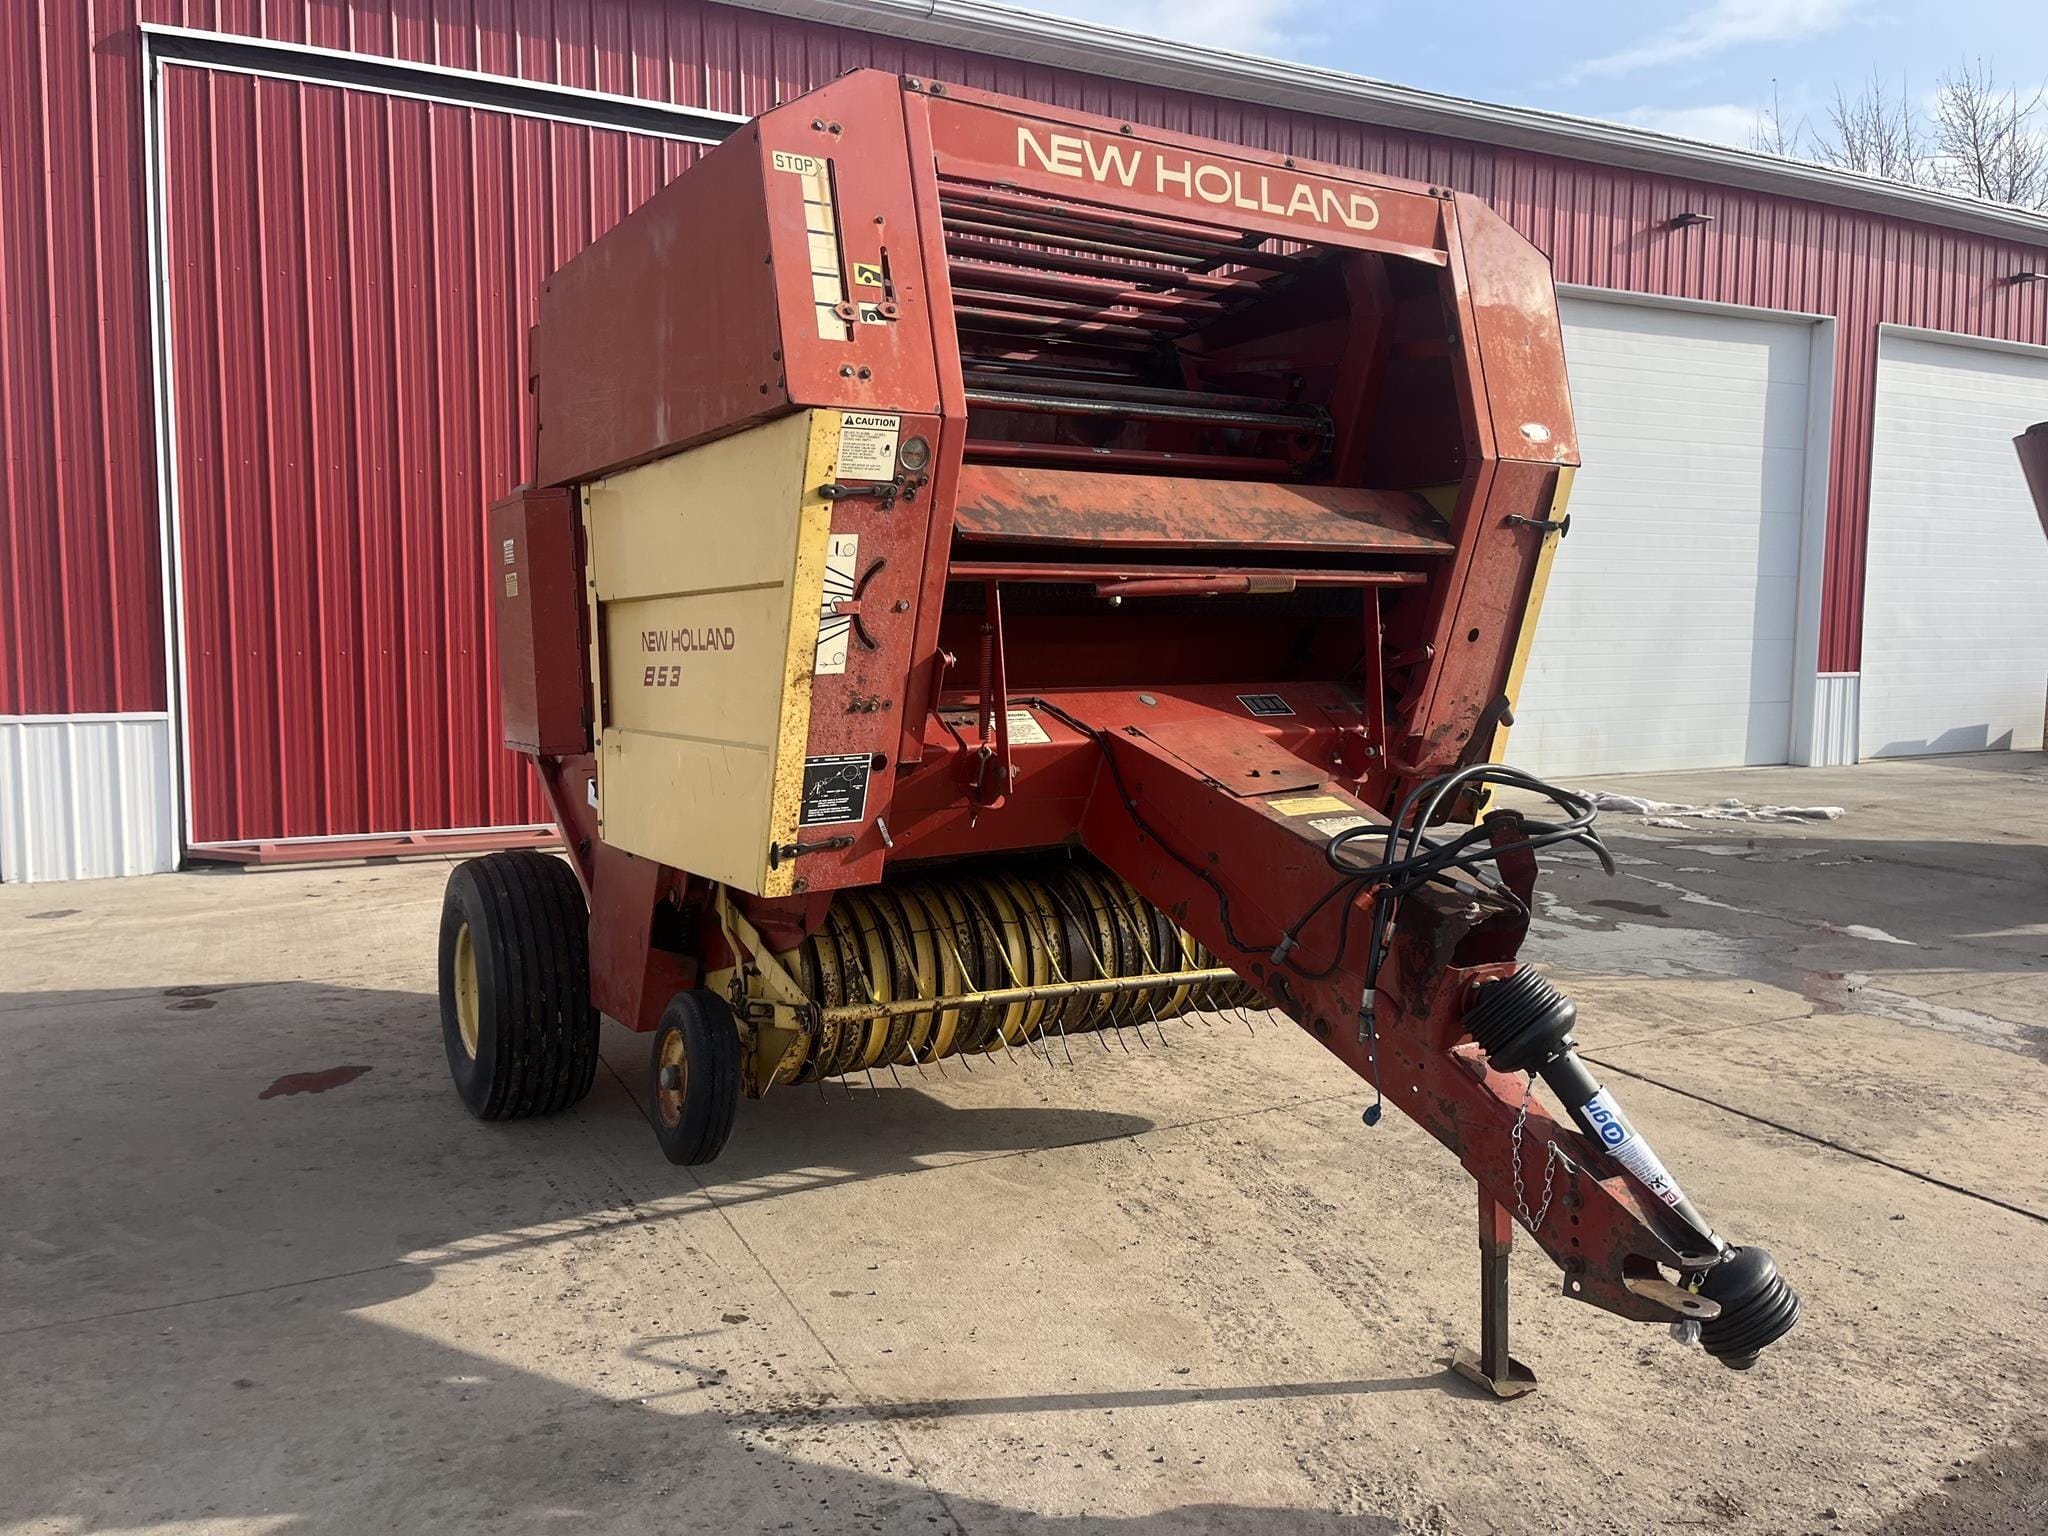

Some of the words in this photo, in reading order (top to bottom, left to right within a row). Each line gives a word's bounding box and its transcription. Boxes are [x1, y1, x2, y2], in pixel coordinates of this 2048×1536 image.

[775, 154, 813, 172] STOP
[1017, 126, 1142, 187] NEW
[1156, 155, 1380, 231] HOLLAND
[855, 416, 896, 427] CAUTION
[641, 630, 668, 652] NEW
[671, 627, 735, 652] HOLLAND
[643, 665, 682, 687] 853
